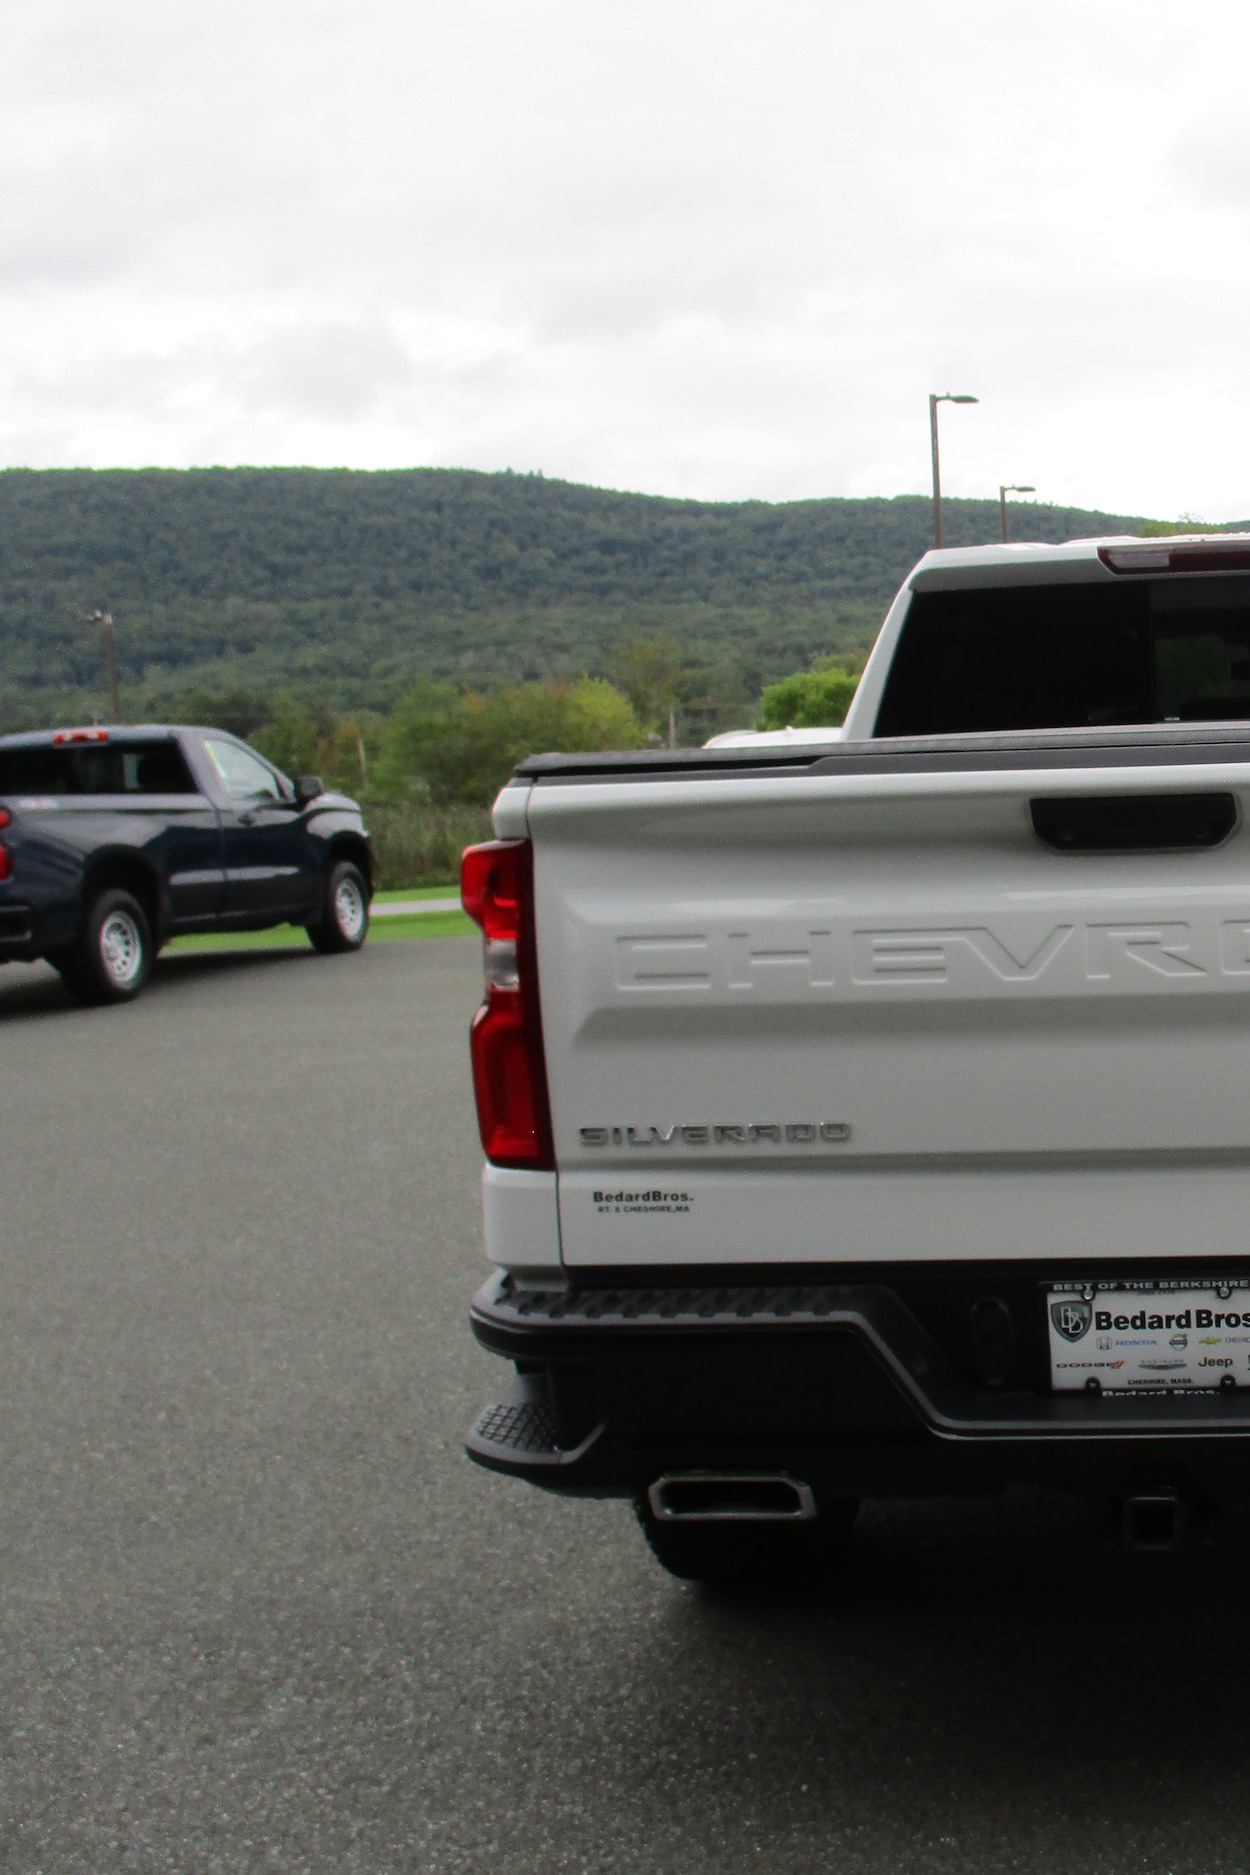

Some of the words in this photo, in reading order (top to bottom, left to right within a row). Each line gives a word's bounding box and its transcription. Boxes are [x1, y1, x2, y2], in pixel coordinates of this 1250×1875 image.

[579, 1121, 852, 1148] SILVERADO
[1052, 1282, 1094, 1291] BEST
[1098, 1282, 1118, 1290] OF
[1122, 1281, 1155, 1290] THE
[1095, 1310, 1192, 1331] Bedard
[1198, 1356, 1234, 1368] Jeep
